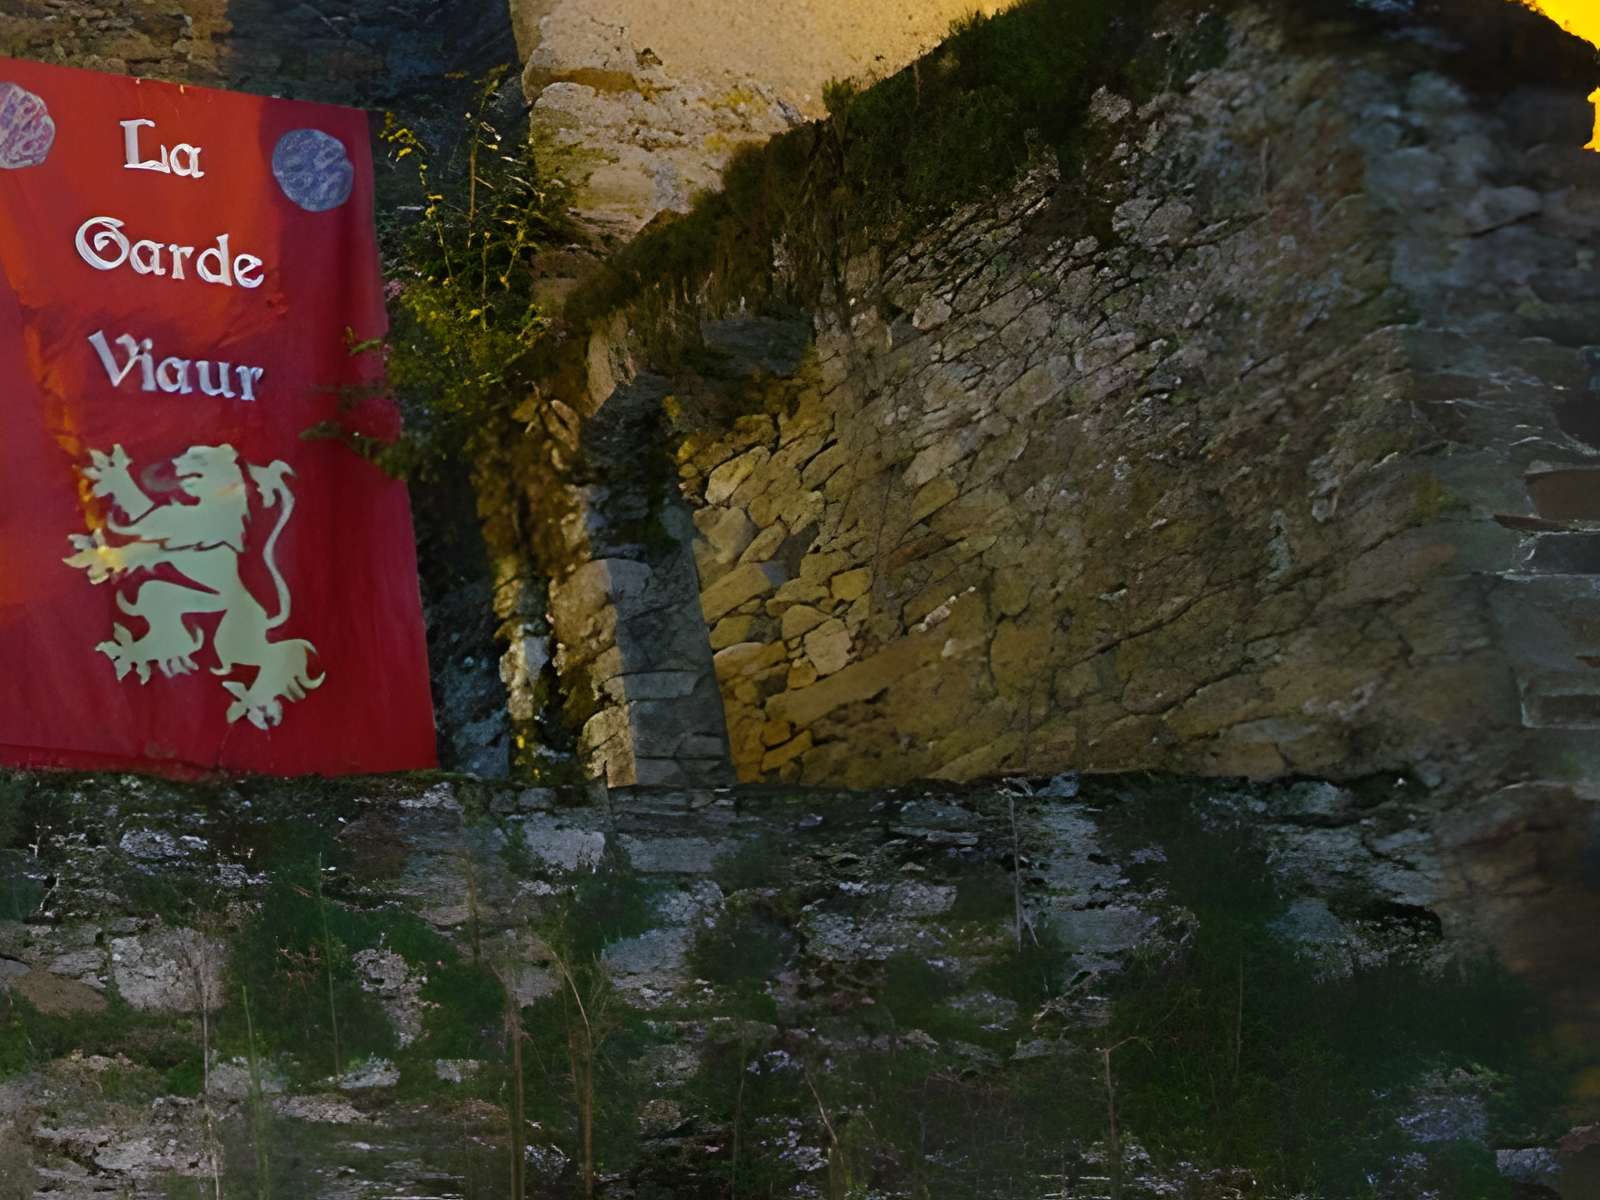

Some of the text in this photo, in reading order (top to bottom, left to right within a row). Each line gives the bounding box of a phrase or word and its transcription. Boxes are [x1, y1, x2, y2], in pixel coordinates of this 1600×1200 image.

[119, 118, 205, 179] La
[74, 216, 265, 289] Garde
[87, 330, 264, 401] Viaur
